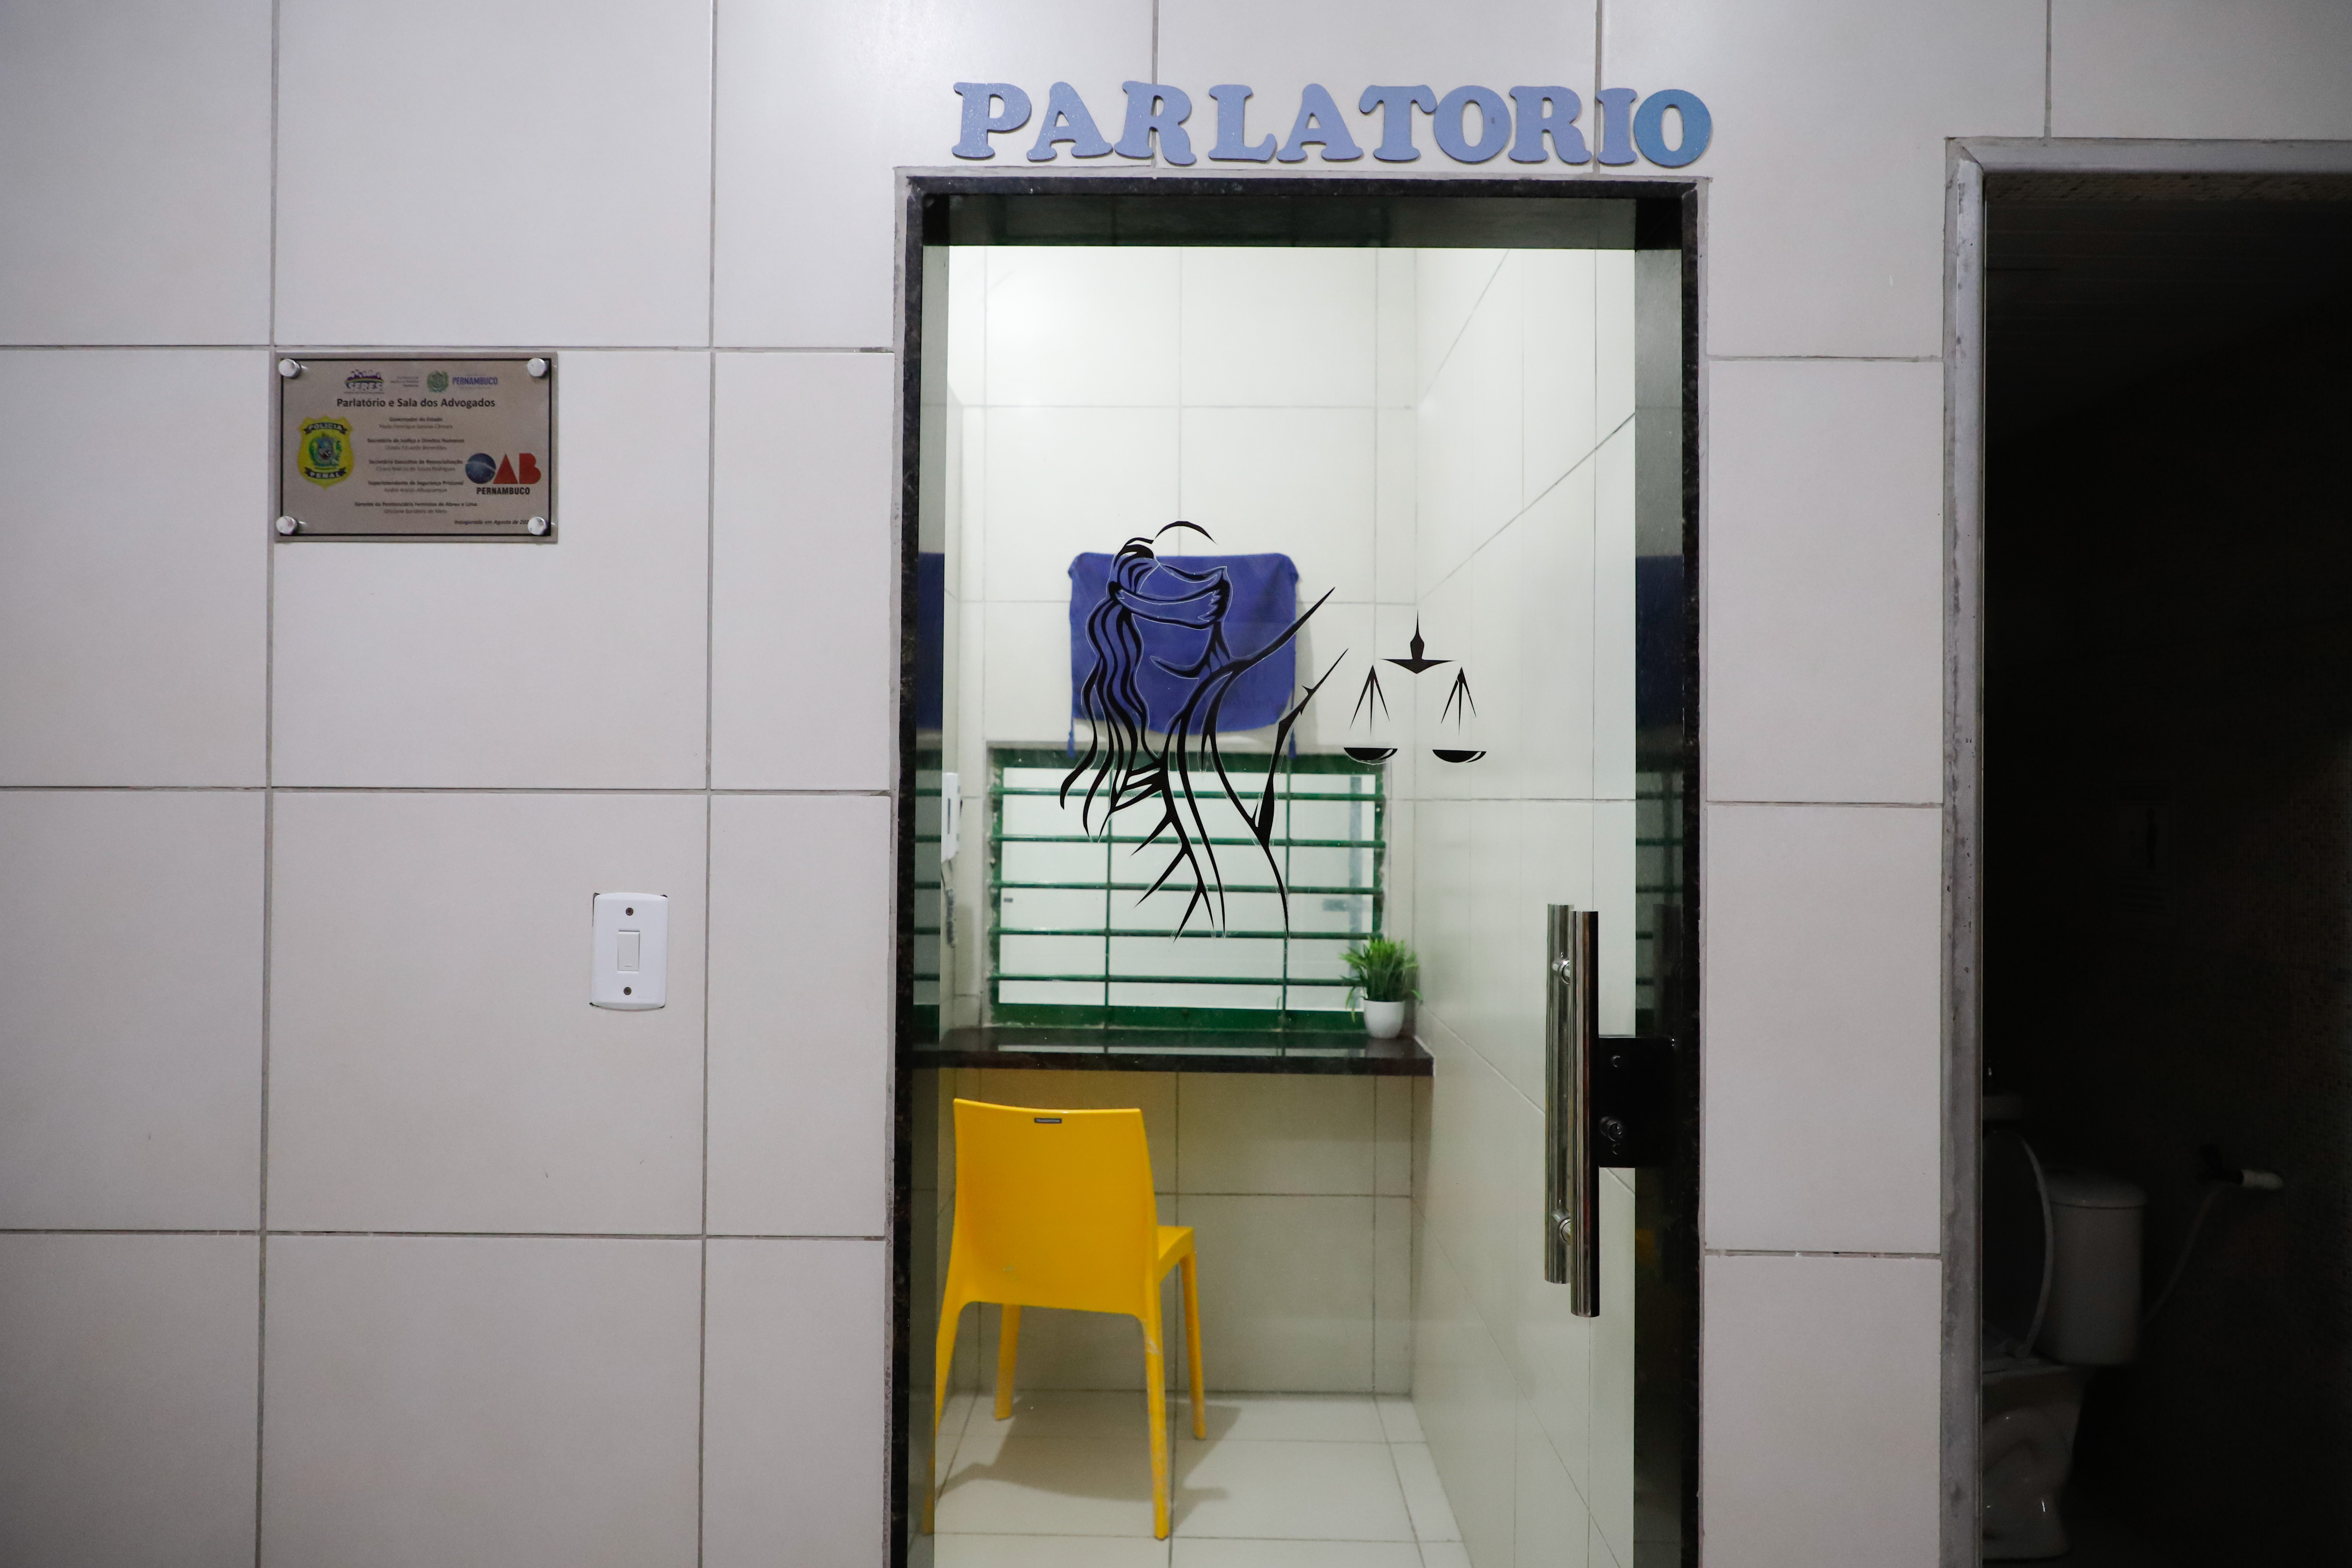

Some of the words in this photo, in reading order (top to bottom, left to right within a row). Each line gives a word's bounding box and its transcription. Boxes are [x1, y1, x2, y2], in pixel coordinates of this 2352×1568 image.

[951, 80, 1714, 167] PARLATORIO
[452, 377, 498, 385] PERNAMBUCO
[337, 398, 386, 407] Parlatório
[397, 398, 418, 407] Sala
[420, 398, 438, 407] dos
[441, 398, 495, 409] Advogados
[465, 453, 542, 484] OAB
[476, 487, 530, 495] PERNAMBUCO
